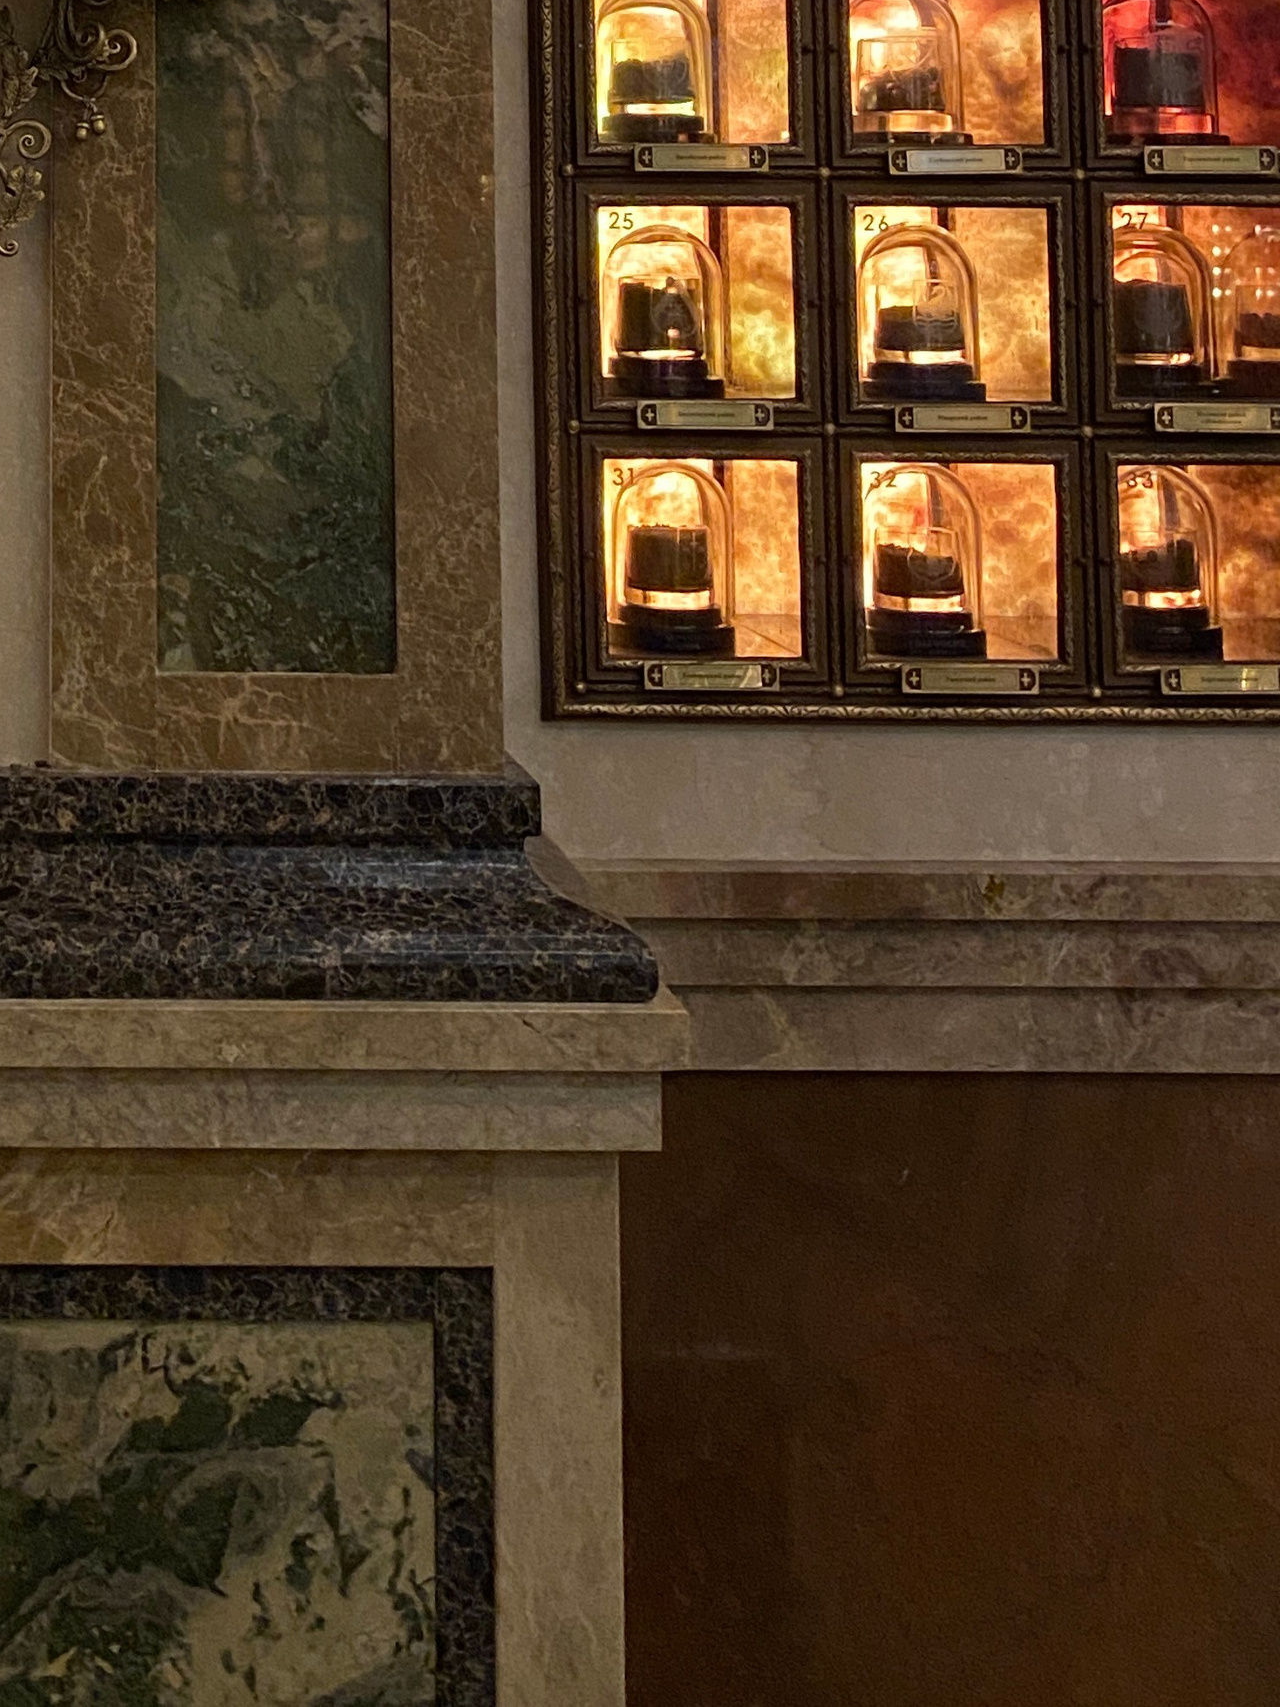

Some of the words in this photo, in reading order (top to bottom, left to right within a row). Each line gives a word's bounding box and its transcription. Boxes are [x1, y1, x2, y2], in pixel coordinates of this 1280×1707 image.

[609, 212, 634, 230] 25
[863, 214, 889, 232] 26
[1121, 213, 1149, 230] 27
[612, 467, 634, 486] 31
[868, 471, 897, 489] 32
